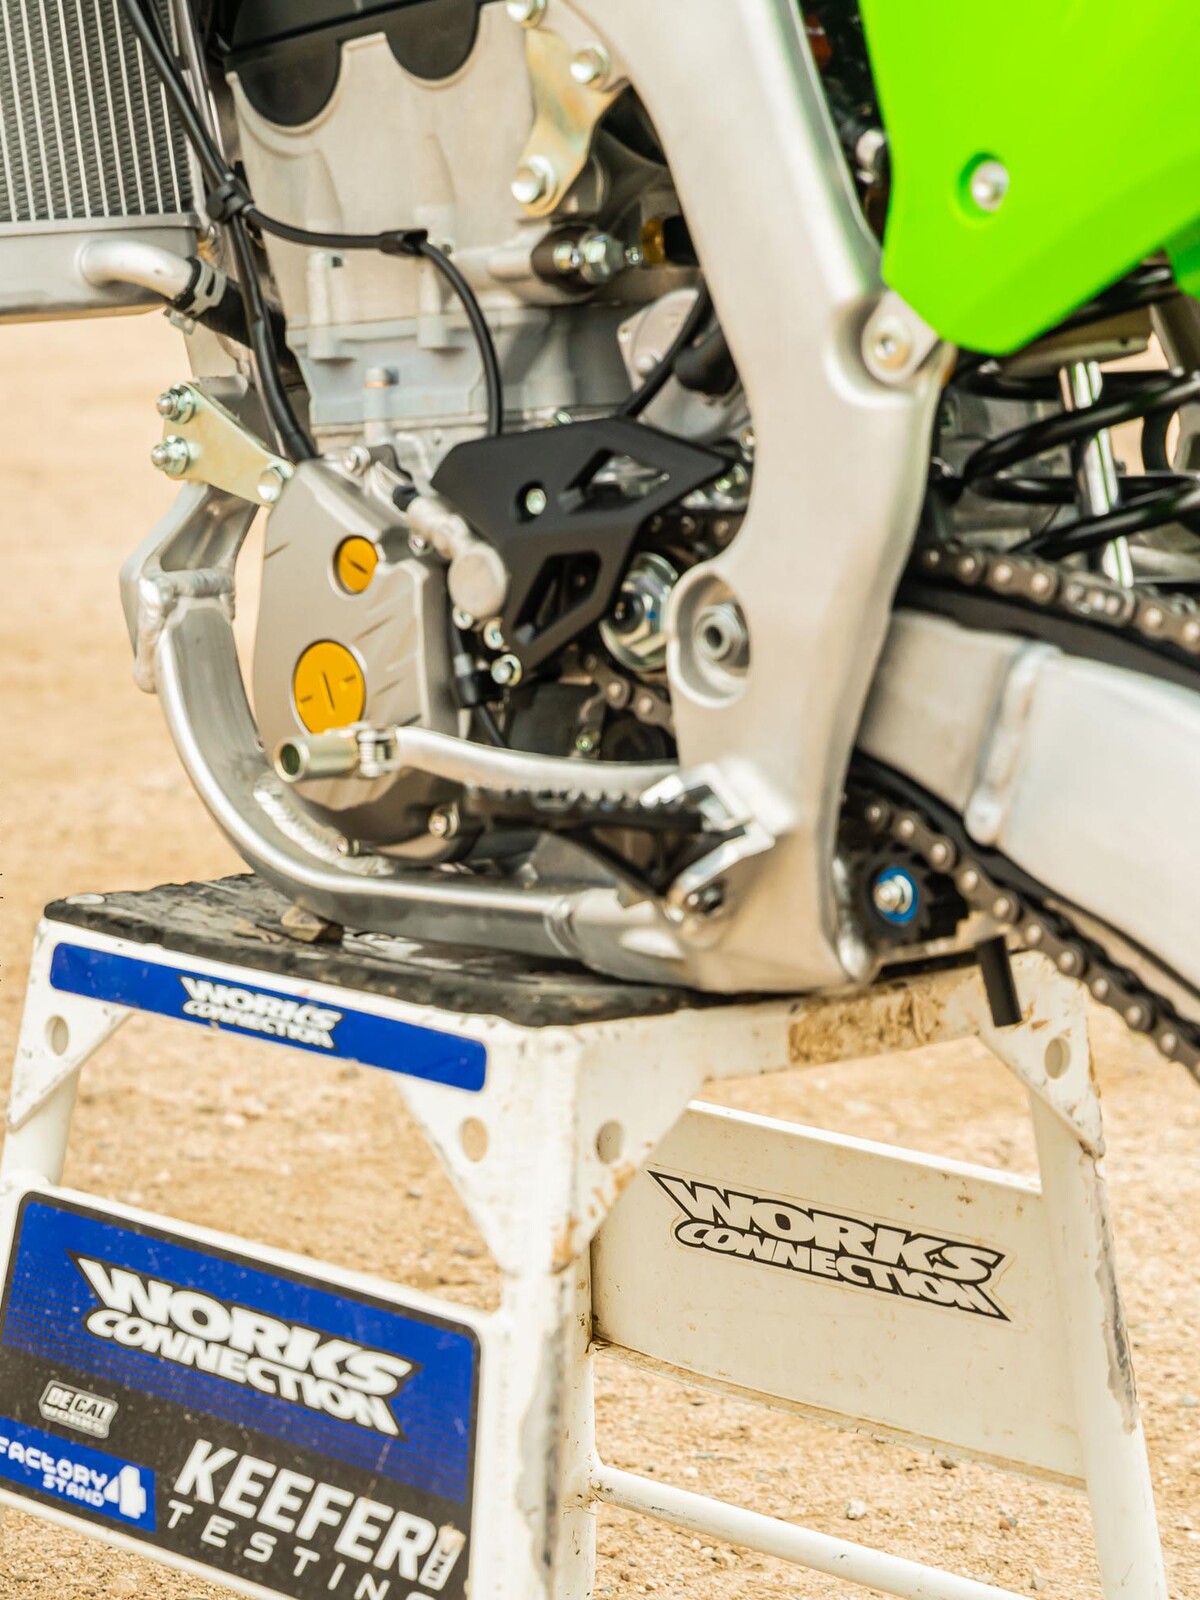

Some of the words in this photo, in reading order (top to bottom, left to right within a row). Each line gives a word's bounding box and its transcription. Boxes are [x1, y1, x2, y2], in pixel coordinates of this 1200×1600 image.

[180, 976, 343, 1032] WORKS
[183, 1000, 336, 1049] CONNECTION
[648, 1171, 1006, 1283] WORKS
[676, 1219, 1011, 1321] CONNECTION
[77, 1257, 413, 1396] WORKS
[87, 1310, 401, 1437] CONNECTION
[42, 1474, 105, 1508] STAND
[173, 1438, 438, 1582] KEEFER
[167, 1499, 437, 1600] TESTIN
